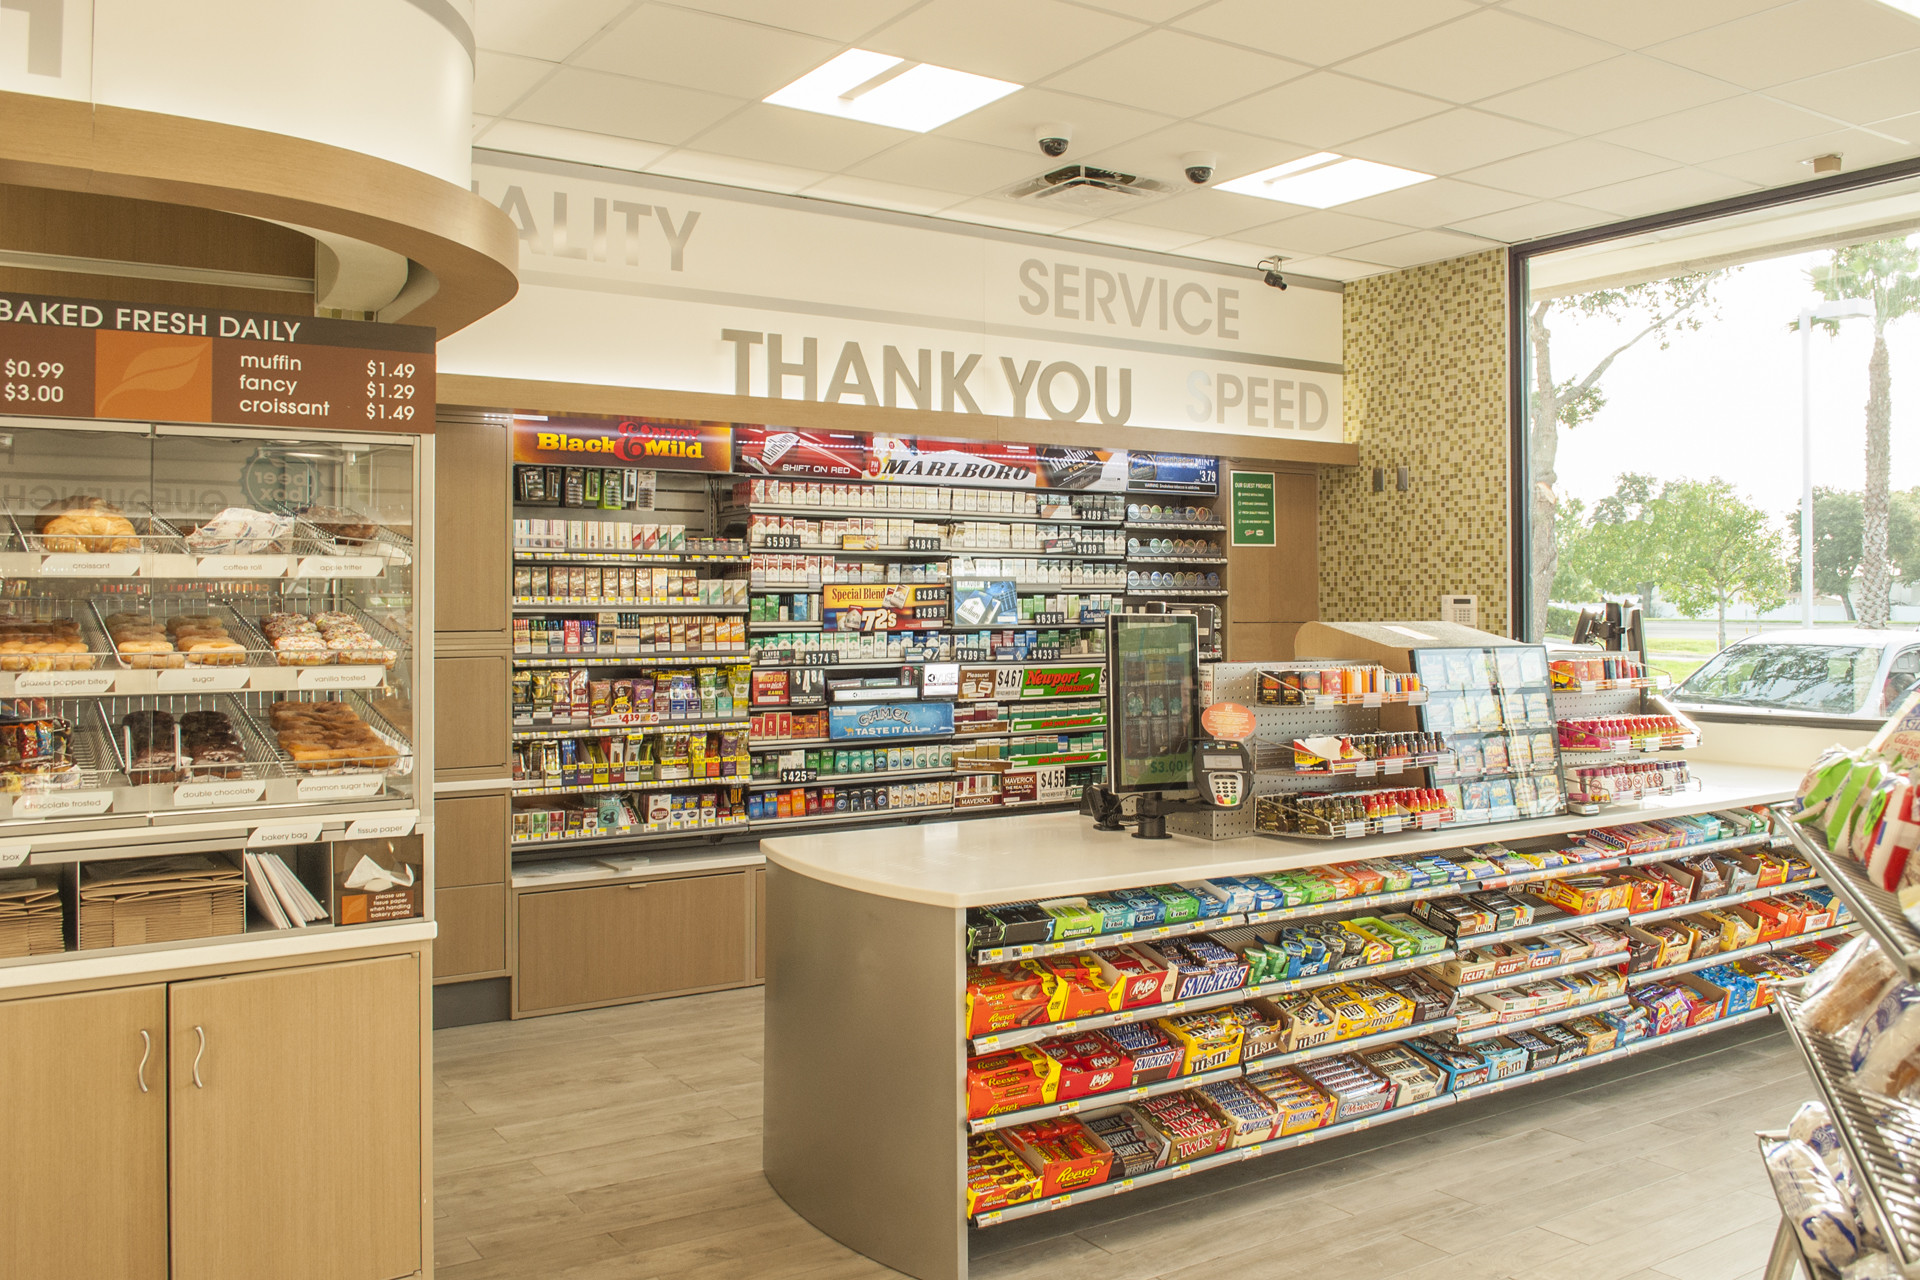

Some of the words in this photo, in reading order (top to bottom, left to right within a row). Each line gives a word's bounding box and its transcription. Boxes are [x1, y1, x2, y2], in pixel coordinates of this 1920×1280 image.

[471, 180, 702, 272] ALITY
[1018, 258, 1240, 340] SERVICE
[0, 299, 103, 327] BAKED
[116, 308, 207, 336] FRESH
[219, 316, 300, 342] DAILY
[4, 359, 64, 380] $0.99
[240, 354, 302, 371] muffin
[366, 360, 416, 379] $1.49
[721, 328, 984, 415] THANK
[999, 356, 1132, 426] YOU
[4, 383, 64, 403] $3.00
[239, 375, 298, 396] fancy
[366, 382, 415, 401] $1.29
[239, 398, 330, 417] croissant
[366, 403, 415, 421] $1.49
[1186, 370, 1329, 432] SPEED
[536, 432, 615, 453] Black
[645, 440, 704, 458] Mild
[782, 464, 811, 472] SHIFT
[883, 458, 1030, 481] MARLBORO
[72, 561, 110, 570] croissant
[223, 563, 244, 571] coffee
[832, 587, 862, 602] Special
[863, 587, 886, 600] Blend
[861, 608, 897, 631] 72's
[86, 677, 108, 686] bites
[191, 675, 215, 684] sugar
[1025, 669, 1081, 688] Newport
[1055, 683, 1094, 695] pleasure!
[858, 707, 912, 726] CAMEL
[855, 727, 889, 735] TASTE
[903, 725, 921, 734] ALL
[182, 790, 208, 799] double
[209, 787, 255, 797] chocolate
[300, 784, 339, 793] cinnamon
[340, 784, 359, 793] sugar
[360, 781, 380, 789] twist
[72, 798, 102, 808] frosted
[261, 832, 289, 842] bakery
[289, 831, 308, 841] bag
[357, 825, 378, 834] tissue
[380, 824, 403, 834] paper
[1590, 828, 1626, 850] mentos
[2, 853, 20, 861] box
[386, 903, 411, 911] handling
[392, 909, 410, 917] goods
[1475, 922, 1493, 934] KIND
[1514, 915, 1532, 926] KIND
[1181, 967, 1247, 999] SNICKERS
[1467, 970, 1484, 981] CLIF
[1135, 1052, 1175, 1071] SNICKERS
[1055, 1165, 1100, 1184] Reese's
